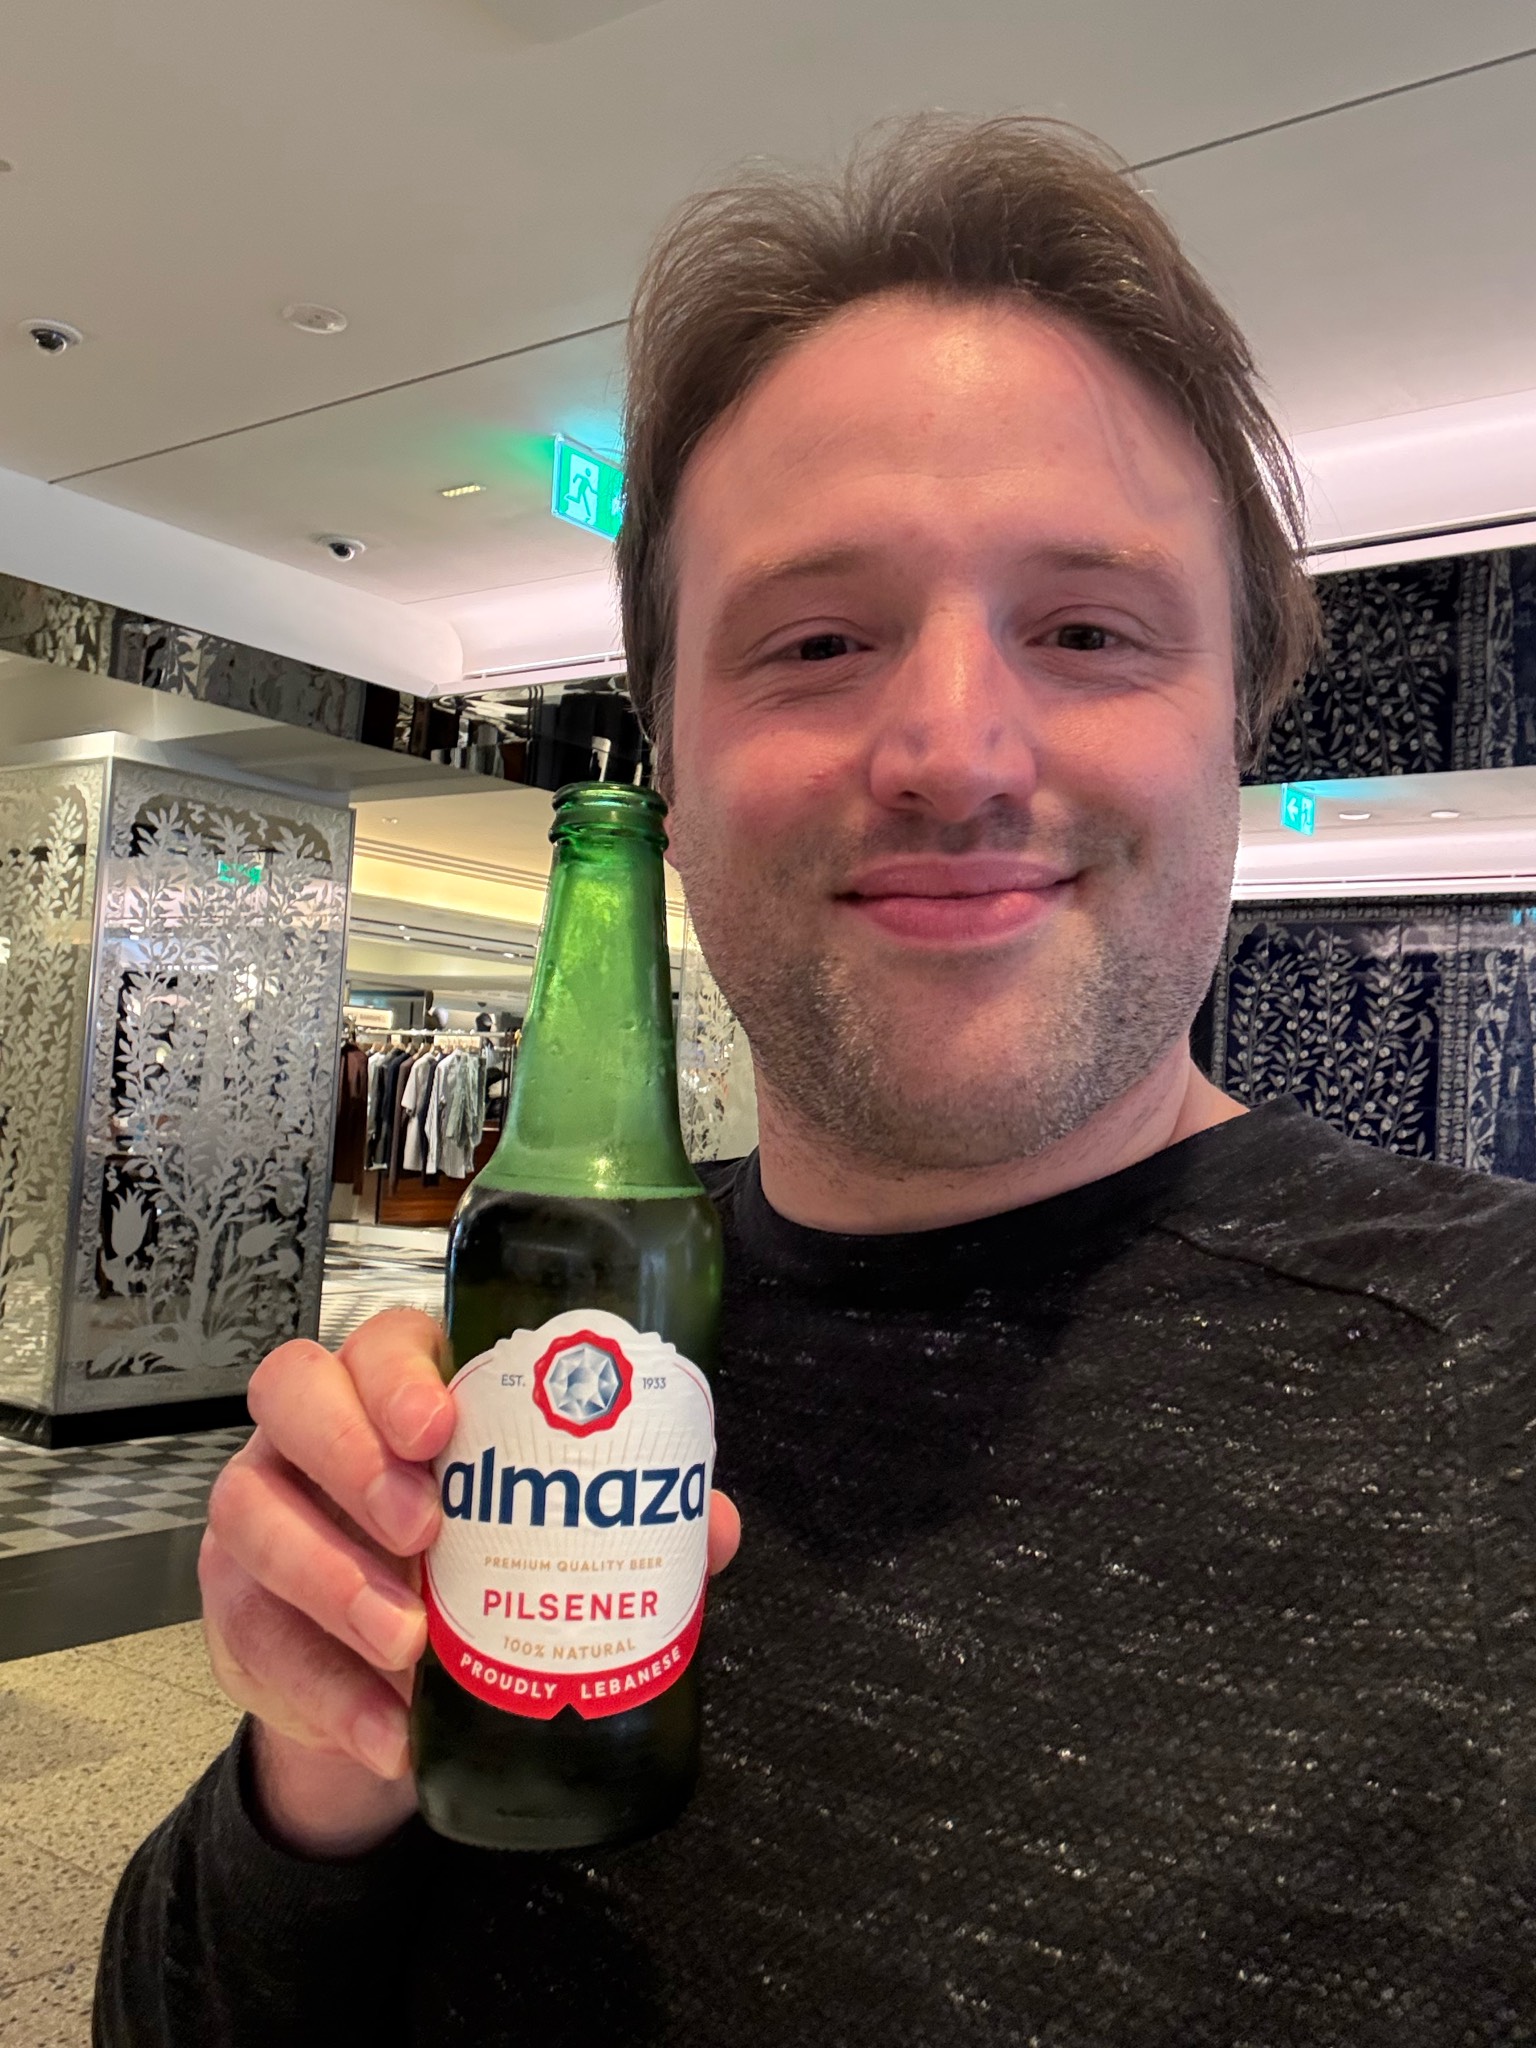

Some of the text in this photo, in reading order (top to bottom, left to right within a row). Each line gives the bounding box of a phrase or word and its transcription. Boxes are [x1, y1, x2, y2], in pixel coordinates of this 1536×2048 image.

[501, 1373, 667, 1390] EST. 1933
[442, 1446, 706, 1528] almaza
[484, 1556, 663, 1573] PREMIUM QUALITY BEER
[483, 1589, 658, 1621] PILSENER
[503, 1636, 636, 1660] 100% NATURAL
[459, 1646, 681, 1699] PROUDLY LEBANESE
